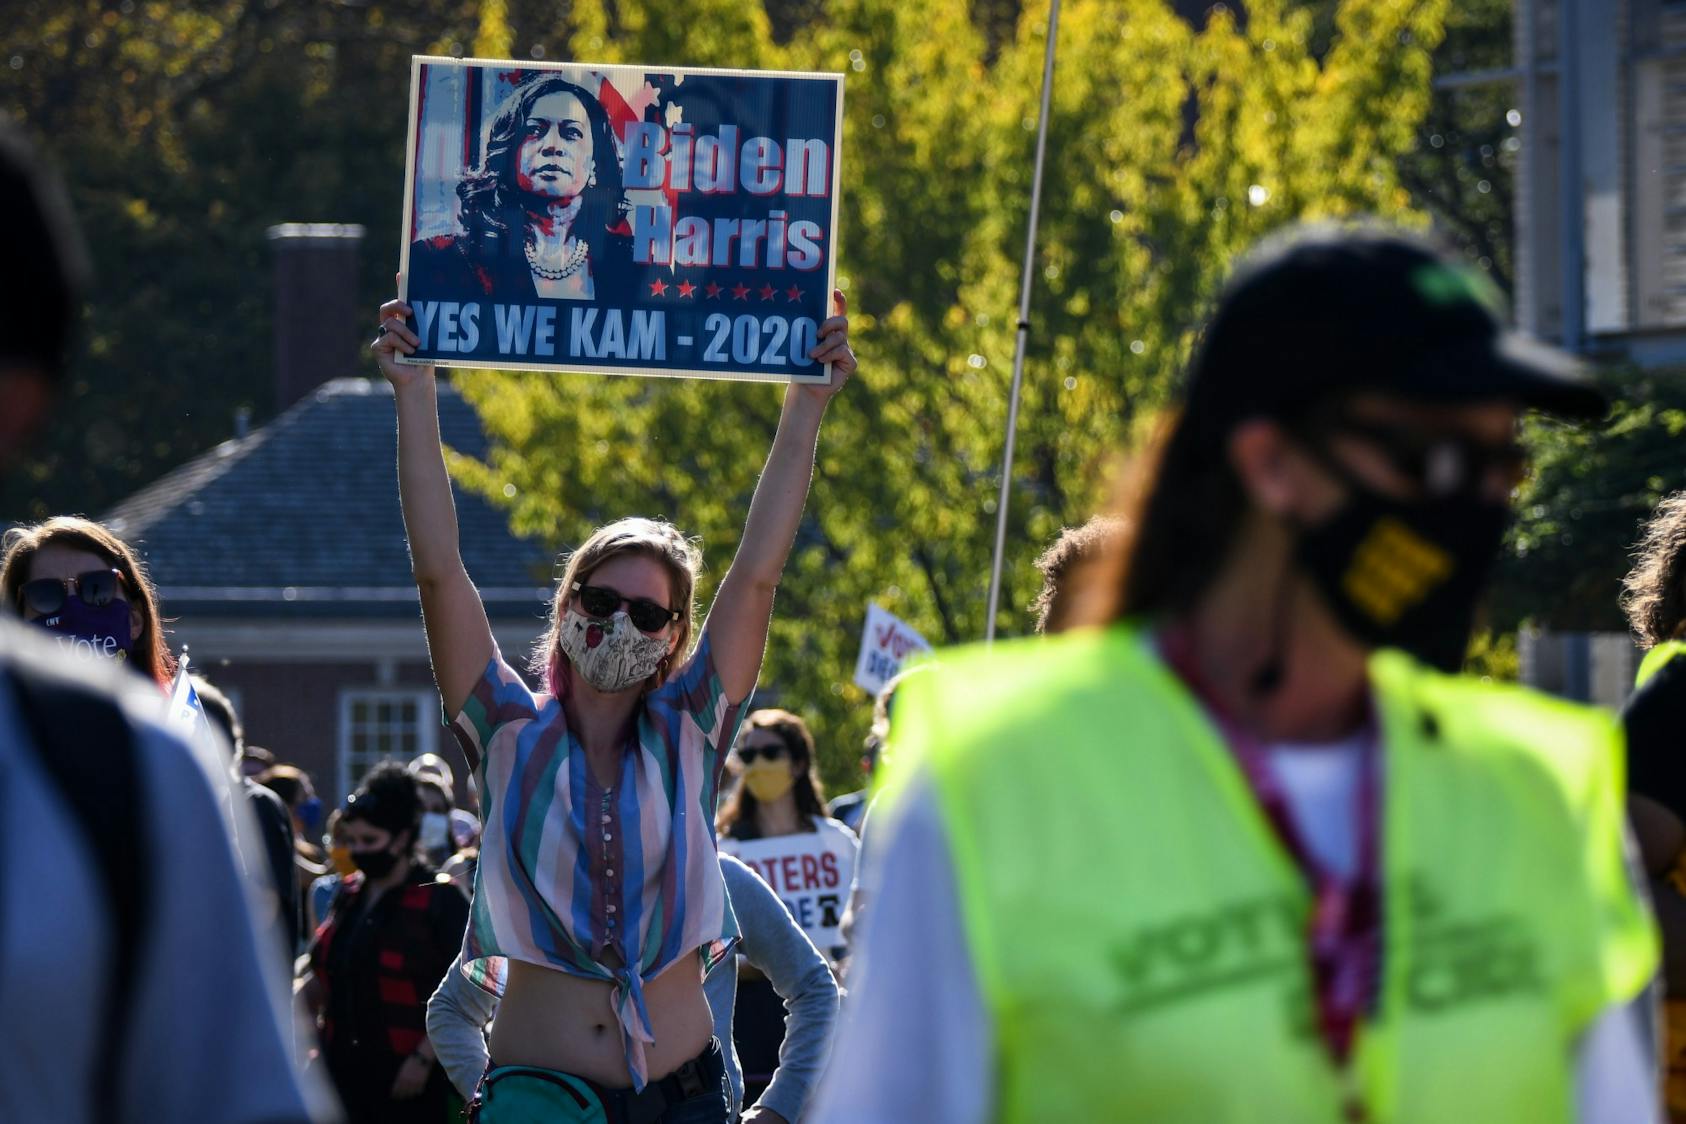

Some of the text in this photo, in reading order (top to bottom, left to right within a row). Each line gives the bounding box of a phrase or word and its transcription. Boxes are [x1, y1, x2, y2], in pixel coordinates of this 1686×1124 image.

[622, 121, 830, 198] Biden
[633, 205, 824, 271] Harris
[412, 301, 481, 353] YES
[494, 304, 556, 356] WE
[570, 307, 667, 361] KAM
[704, 312, 819, 367] 2020
[55, 633, 118, 662] Vote
[733, 851, 839, 892] TERS
